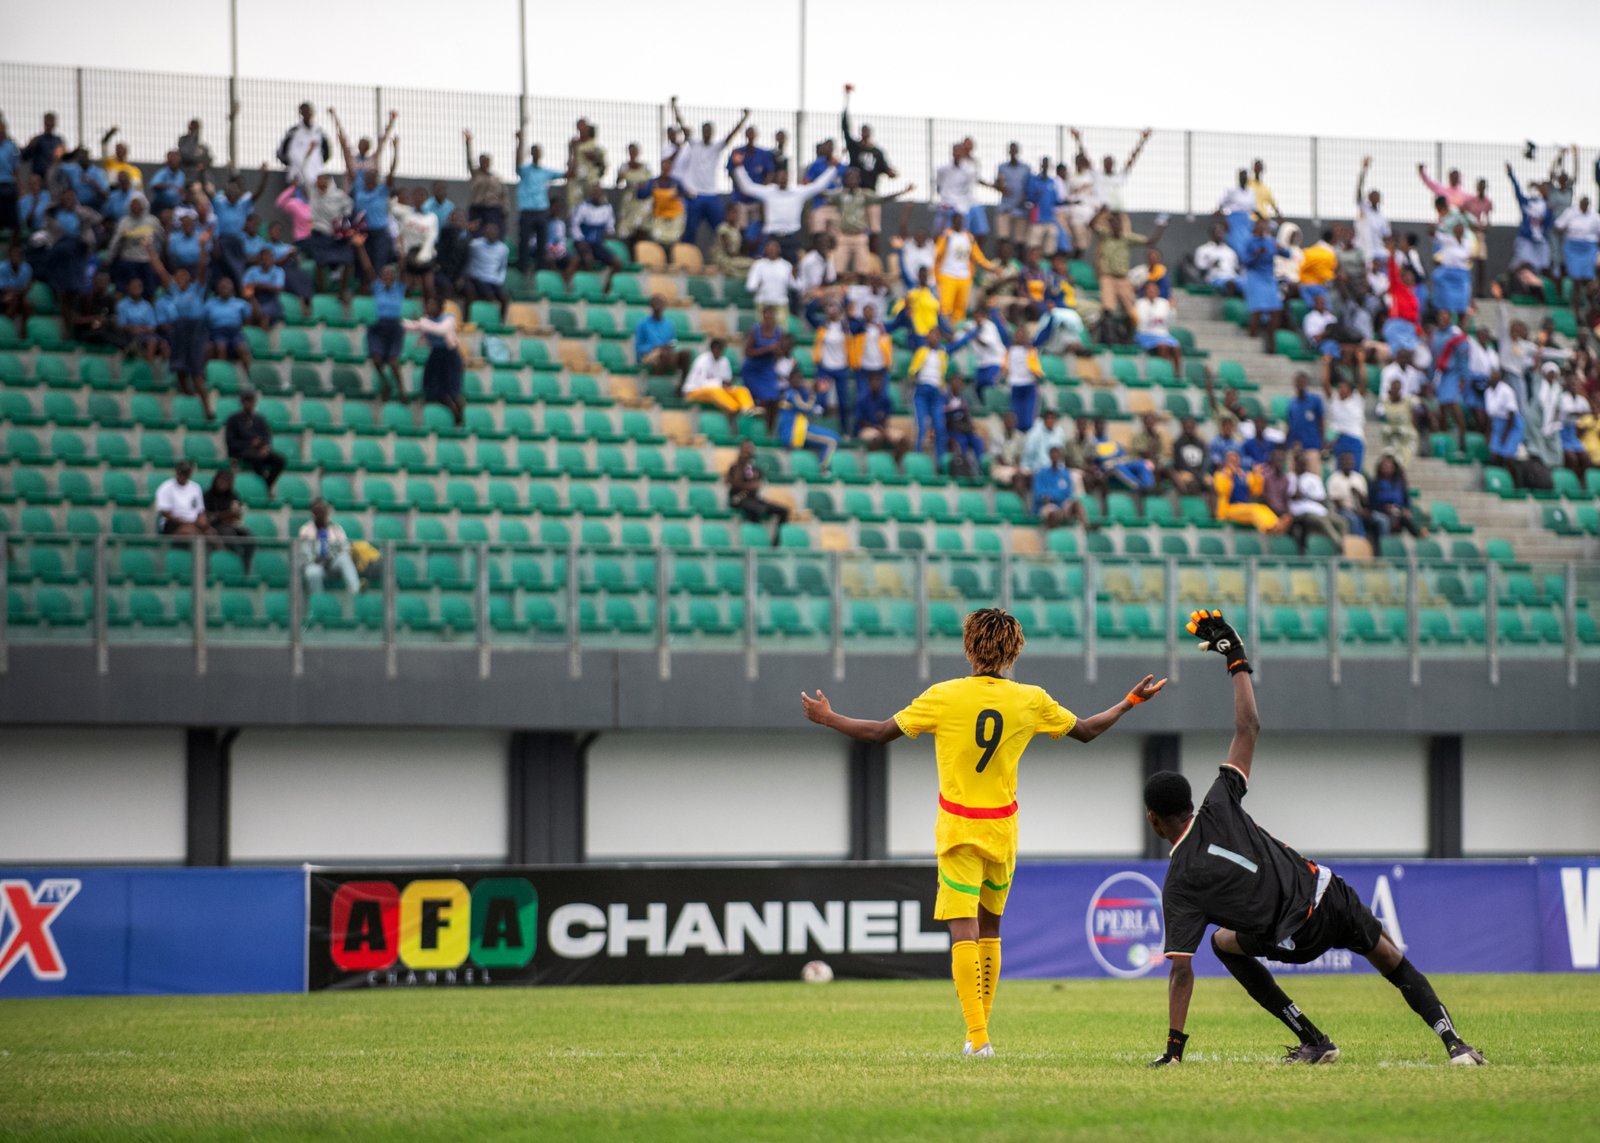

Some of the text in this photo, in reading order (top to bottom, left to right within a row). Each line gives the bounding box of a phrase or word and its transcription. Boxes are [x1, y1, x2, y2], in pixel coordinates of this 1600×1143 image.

[975, 708, 1004, 773] 9
[1207, 843, 1258, 873] 1
[0, 879, 81, 981] X
[343, 895, 950, 959] AFA CHANNEL
[1096, 909, 1160, 935] PERLA
[366, 967, 492, 987] CHANNEL
